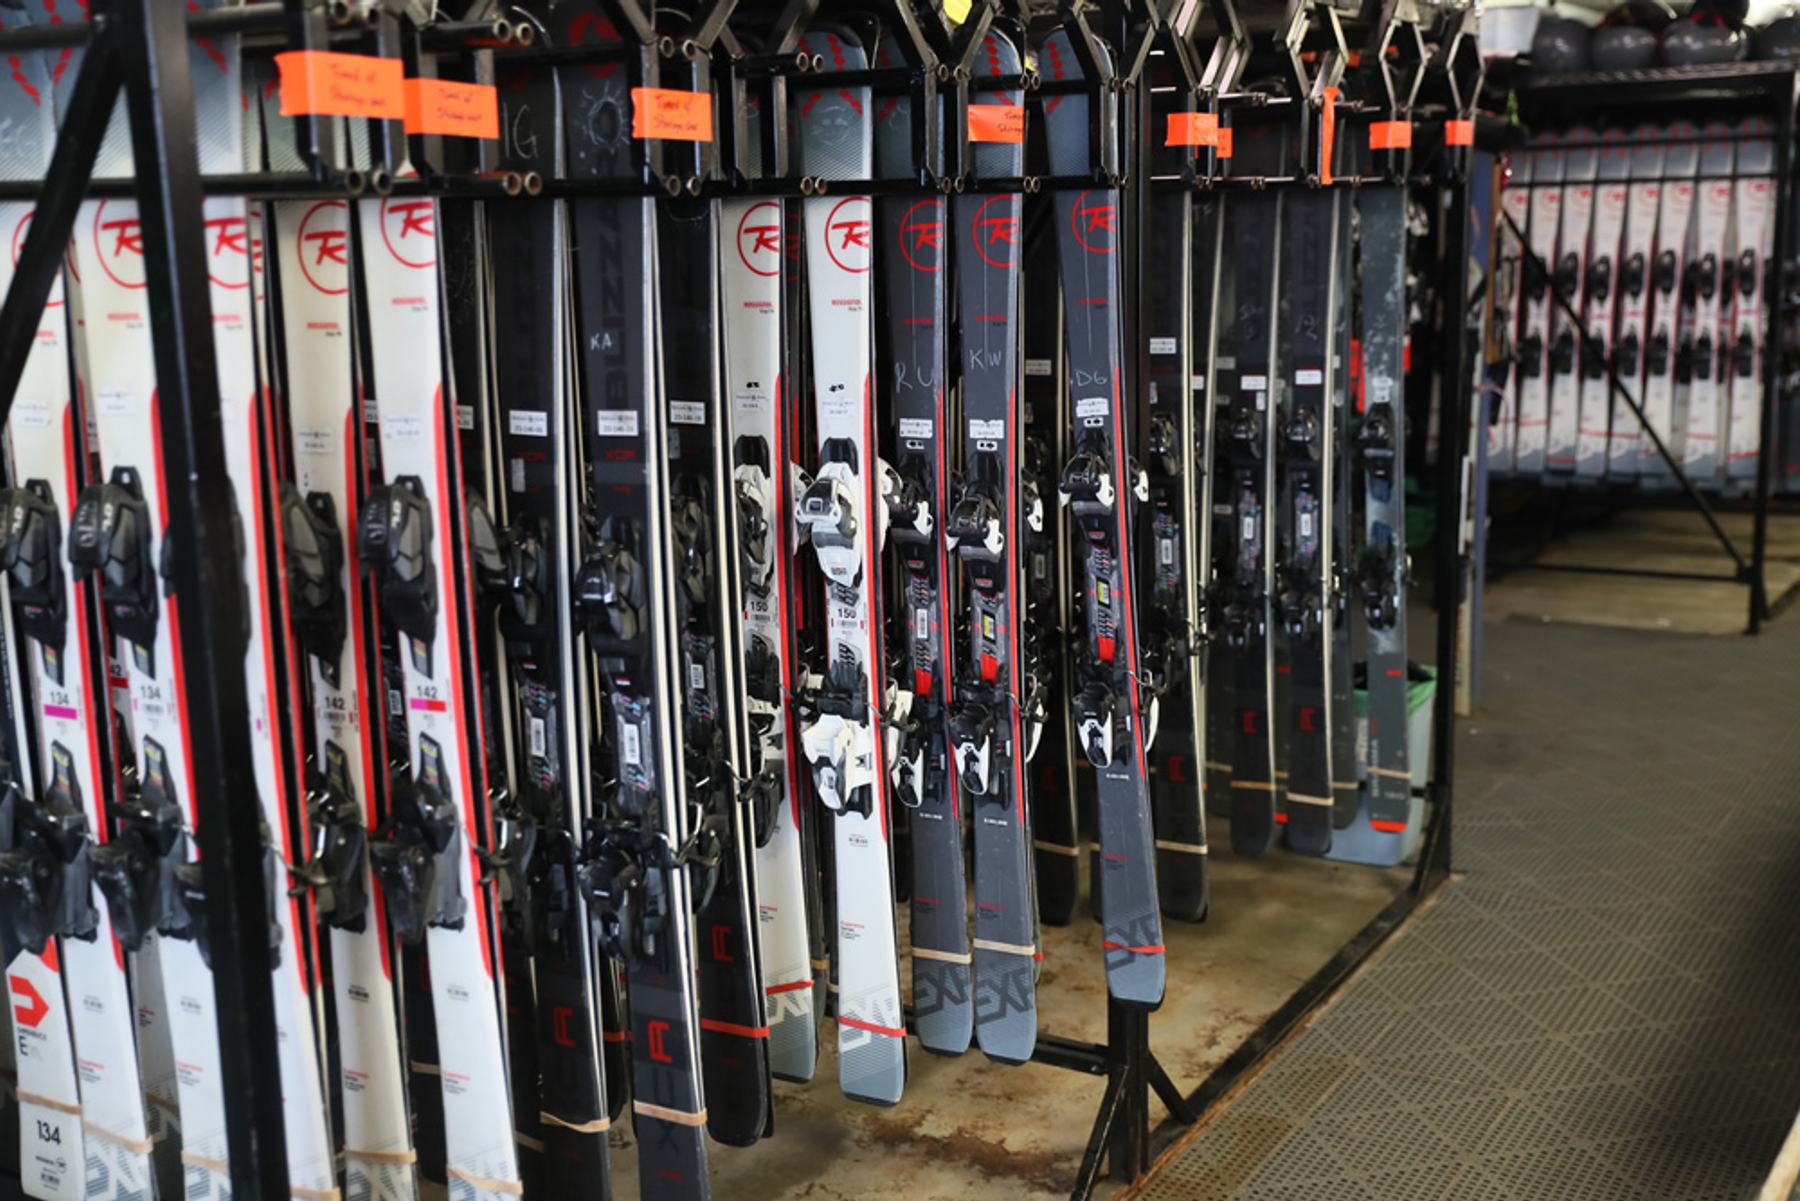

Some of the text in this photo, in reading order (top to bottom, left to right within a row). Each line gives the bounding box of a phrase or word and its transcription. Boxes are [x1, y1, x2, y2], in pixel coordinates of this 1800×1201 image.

[590, 332, 613, 352] KA
[969, 348, 1002, 371] KW
[750, 600, 769, 612] 150
[837, 608, 857, 620] 150
[49, 690, 70, 706] 134
[140, 685, 161, 700] 134
[416, 685, 438, 699] 142
[324, 696, 346, 711] 142
[36, 1119, 62, 1146] 134
